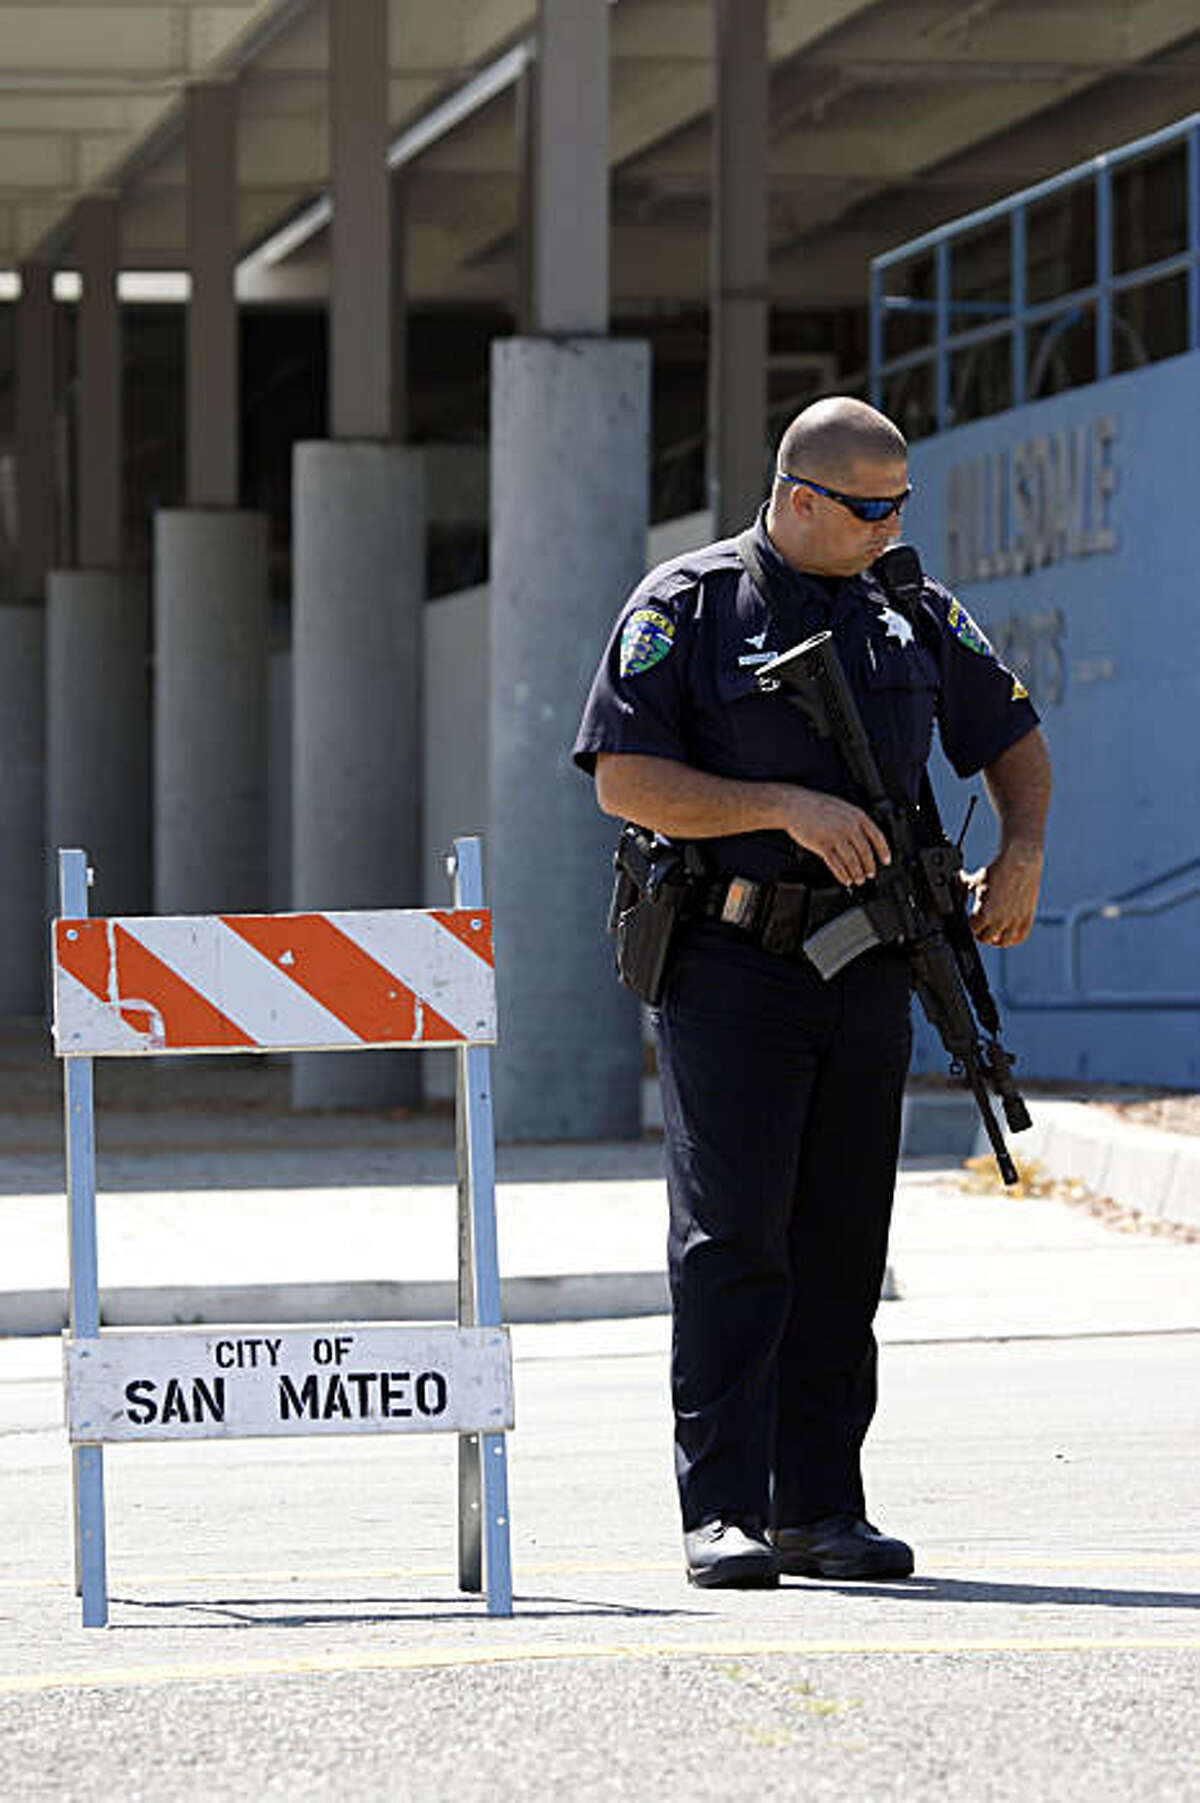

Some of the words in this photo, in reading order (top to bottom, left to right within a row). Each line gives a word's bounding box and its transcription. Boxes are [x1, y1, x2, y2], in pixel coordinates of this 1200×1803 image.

[216, 1339, 281, 1368] CITY
[314, 1338, 353, 1365] OF
[126, 1377, 224, 1424] SAN
[280, 1372, 446, 1419] MATEO
